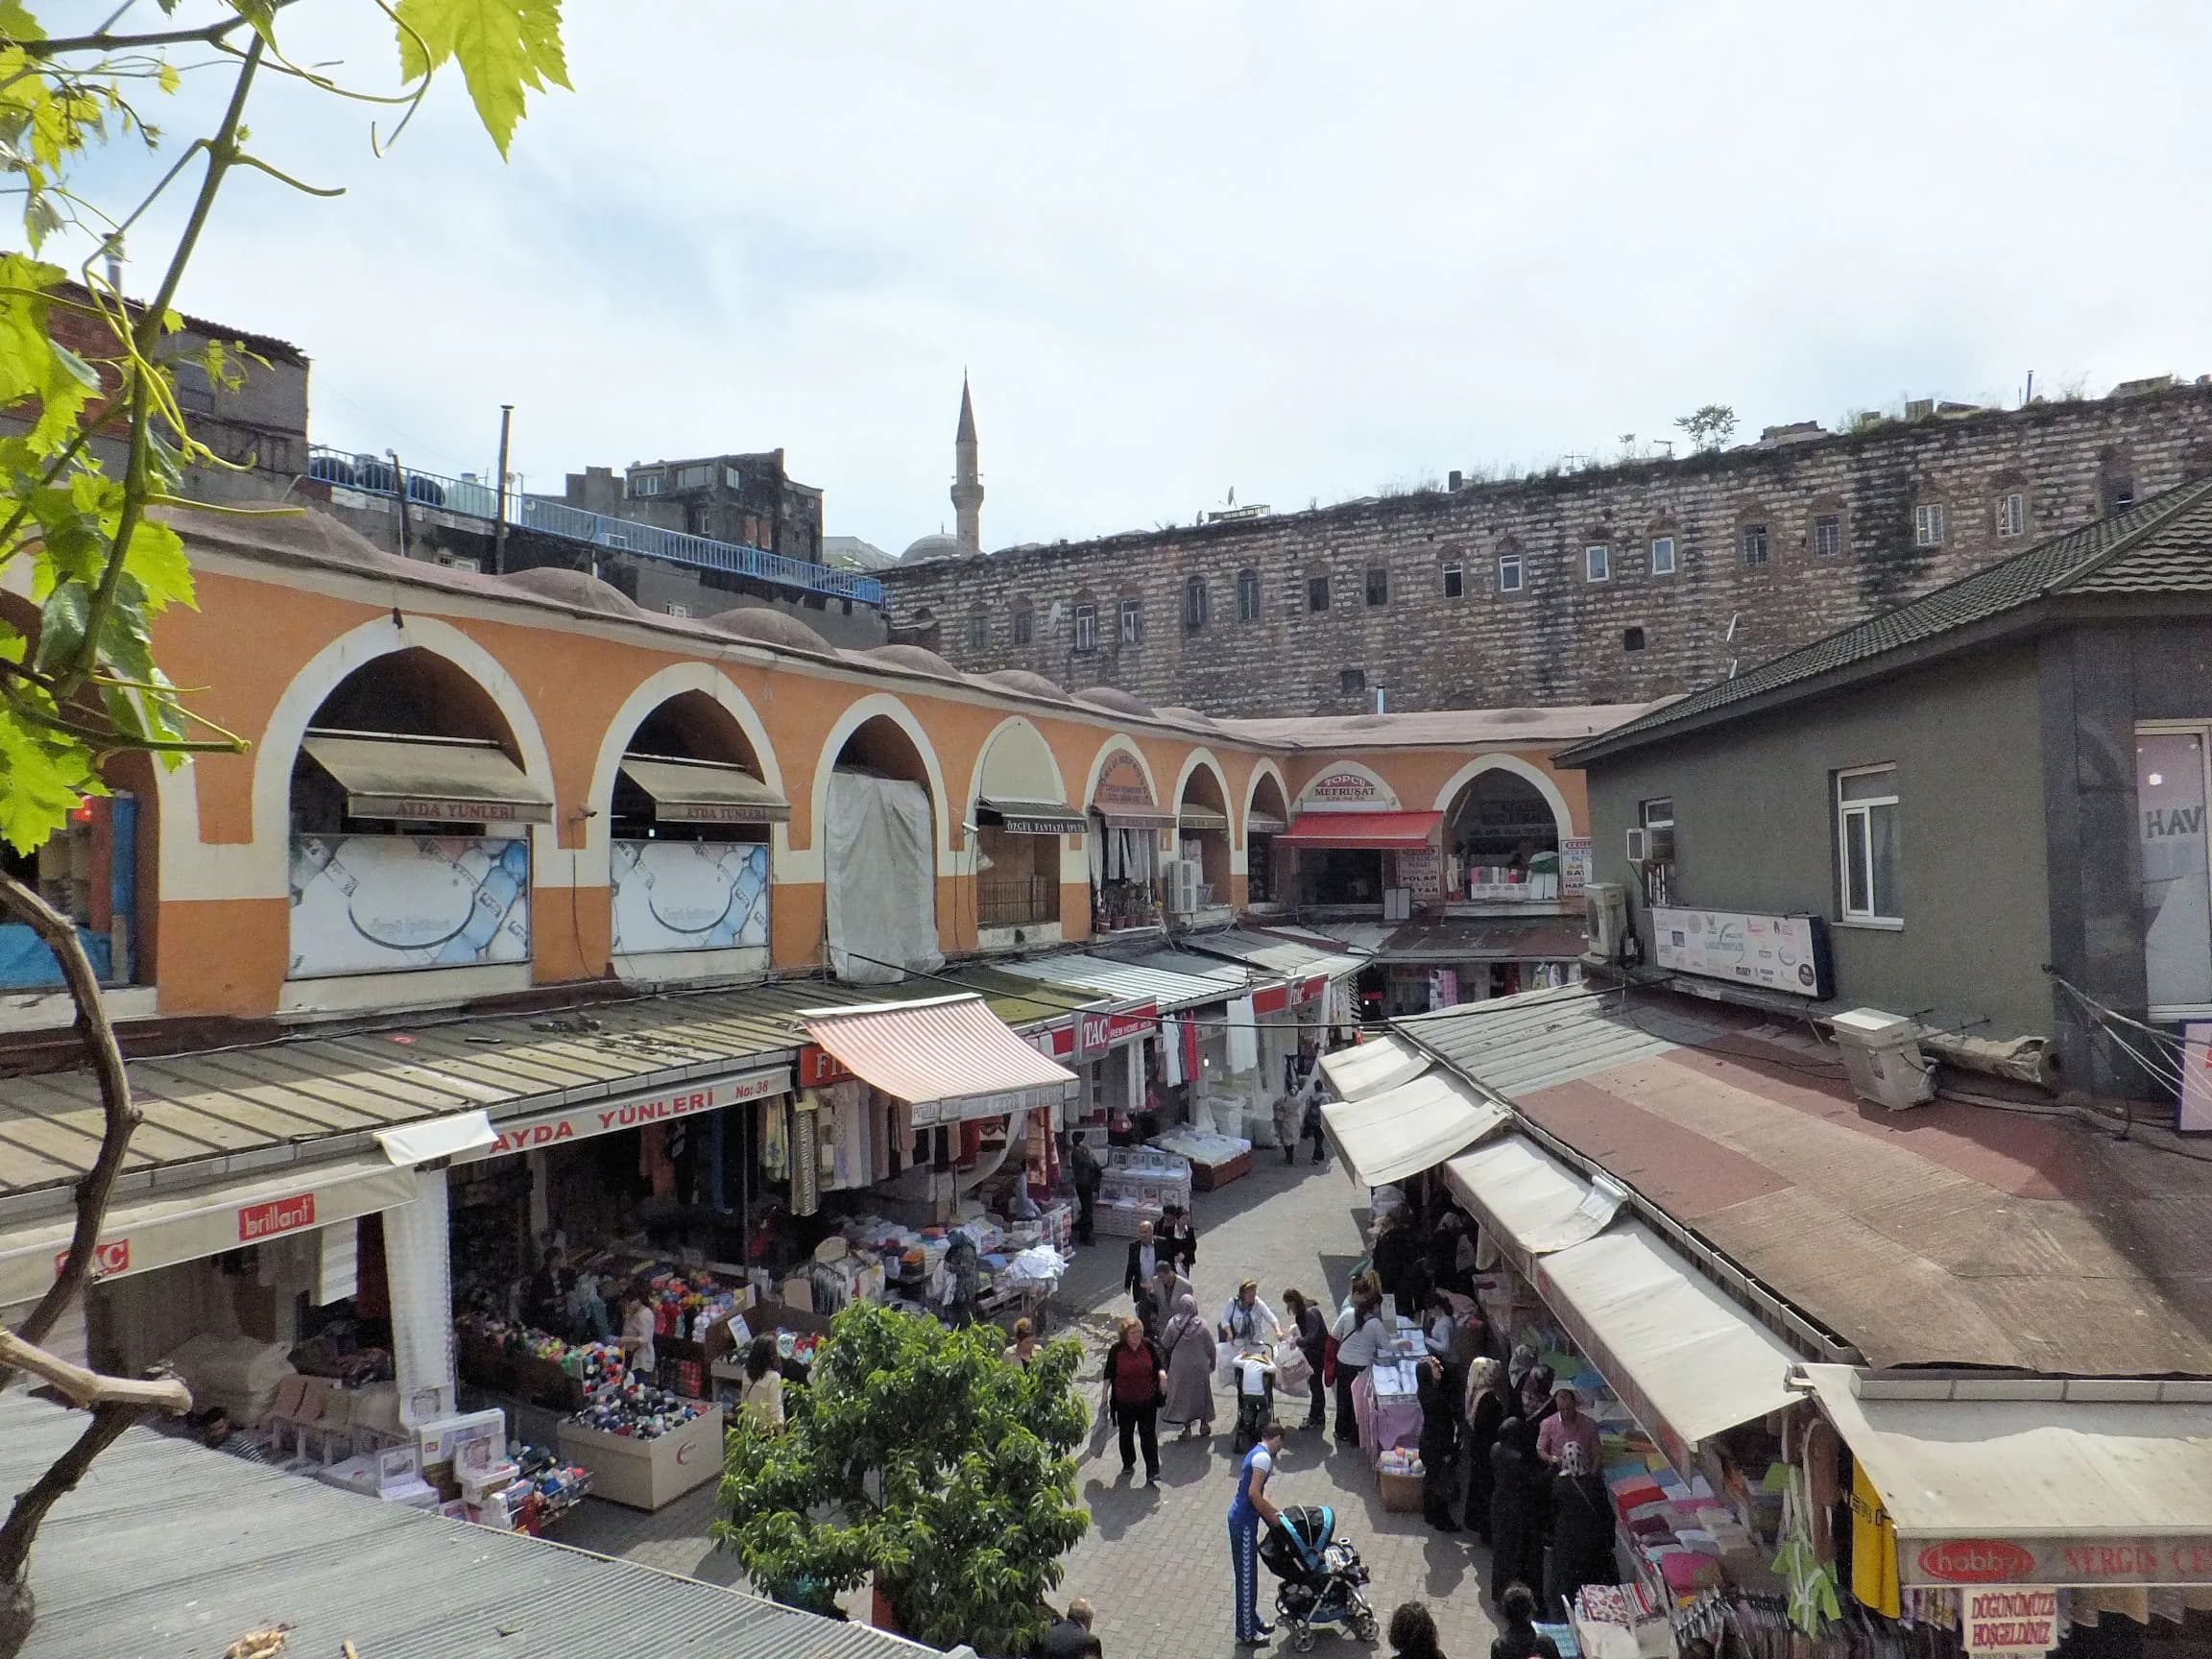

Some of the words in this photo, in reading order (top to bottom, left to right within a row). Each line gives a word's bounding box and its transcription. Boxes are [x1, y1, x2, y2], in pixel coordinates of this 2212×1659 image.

[1007, 820, 1032, 831] ÖZGÜL
[489, 1121, 574, 1153] AYDA
[598, 1088, 713, 1129] YÜNLERİ
[756, 1080, 768, 1094] 38
[245, 1198, 309, 1237] brillant
